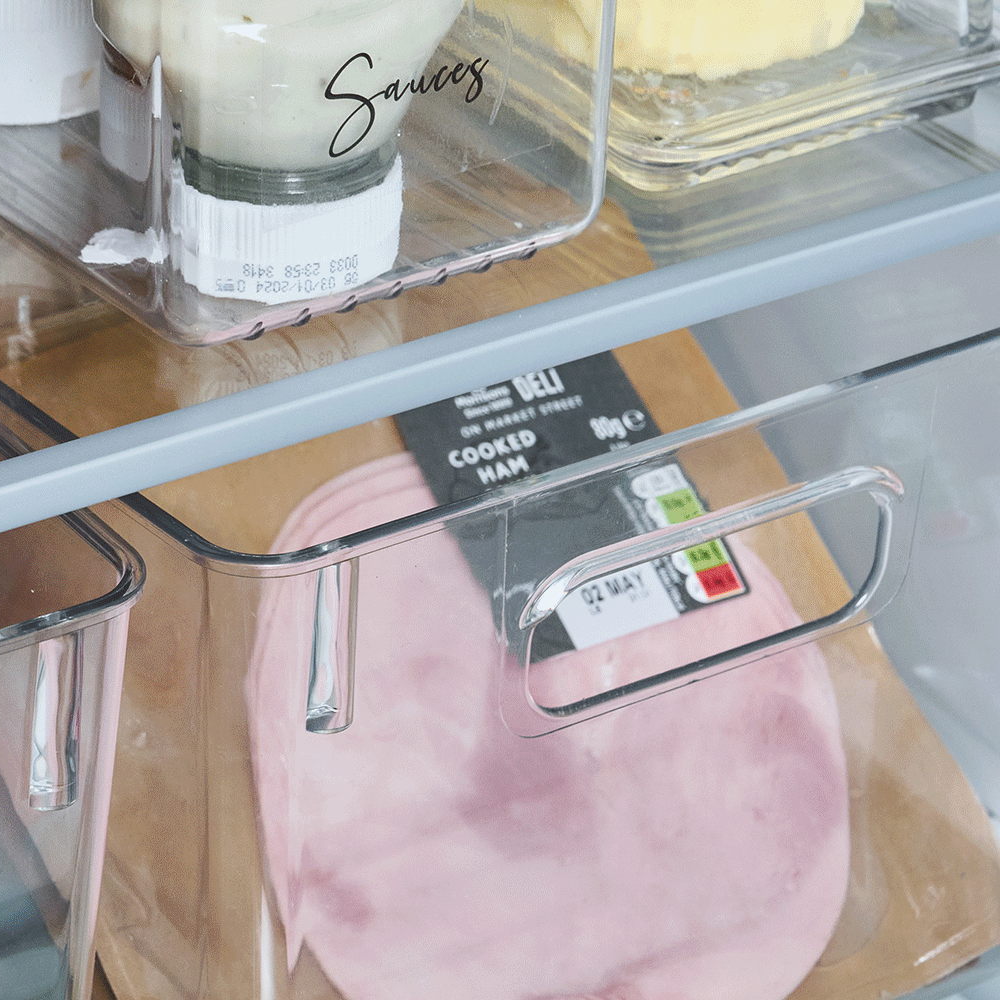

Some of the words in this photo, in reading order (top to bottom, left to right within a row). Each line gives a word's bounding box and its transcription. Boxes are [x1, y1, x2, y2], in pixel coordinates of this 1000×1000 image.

[324, 51, 490, 159] Sauces
[242, 263, 275, 278] 3418
[256, 276, 336, 293] 03/01/2024
[284, 262, 321, 279] 23:58
[511, 367, 566, 401] DELI
[448, 429, 537, 468] COOKED
[476, 454, 531, 485] HAM
[580, 583, 605, 605] 02
[604, 570, 645, 599] MAY
